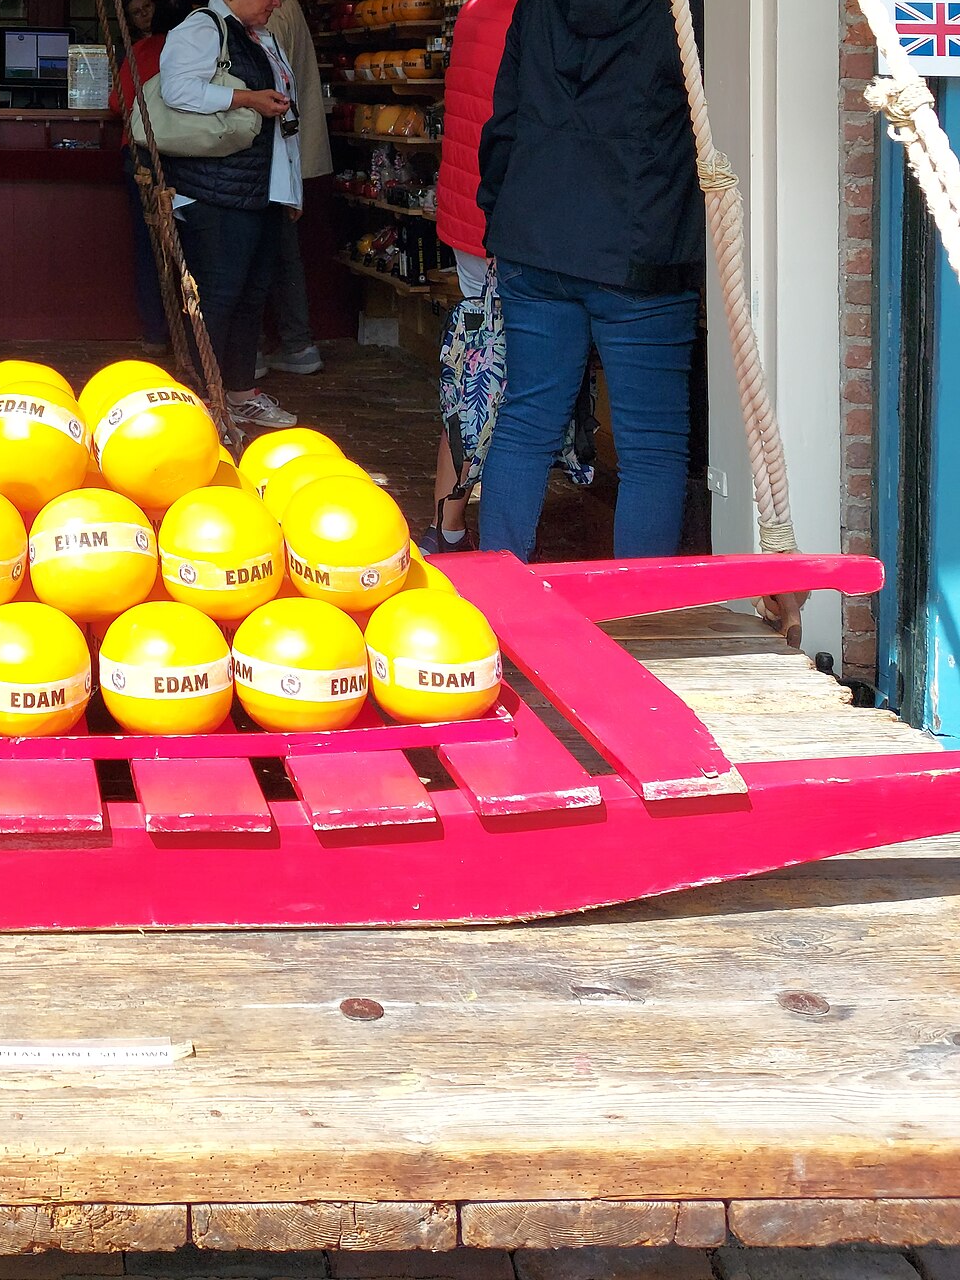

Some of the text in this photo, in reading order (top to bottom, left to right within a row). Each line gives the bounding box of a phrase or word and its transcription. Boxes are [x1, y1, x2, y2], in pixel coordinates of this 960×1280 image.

[146, 391, 196, 406] EDAM
[225, 560, 274, 586] EDAM
[290, 554, 331, 586] EDAM
[231, 656, 253, 682] DAM
[418, 669, 476, 688] EDAM
[154, 672, 209, 694] EDAM
[10, 688, 66, 709] EDAM
